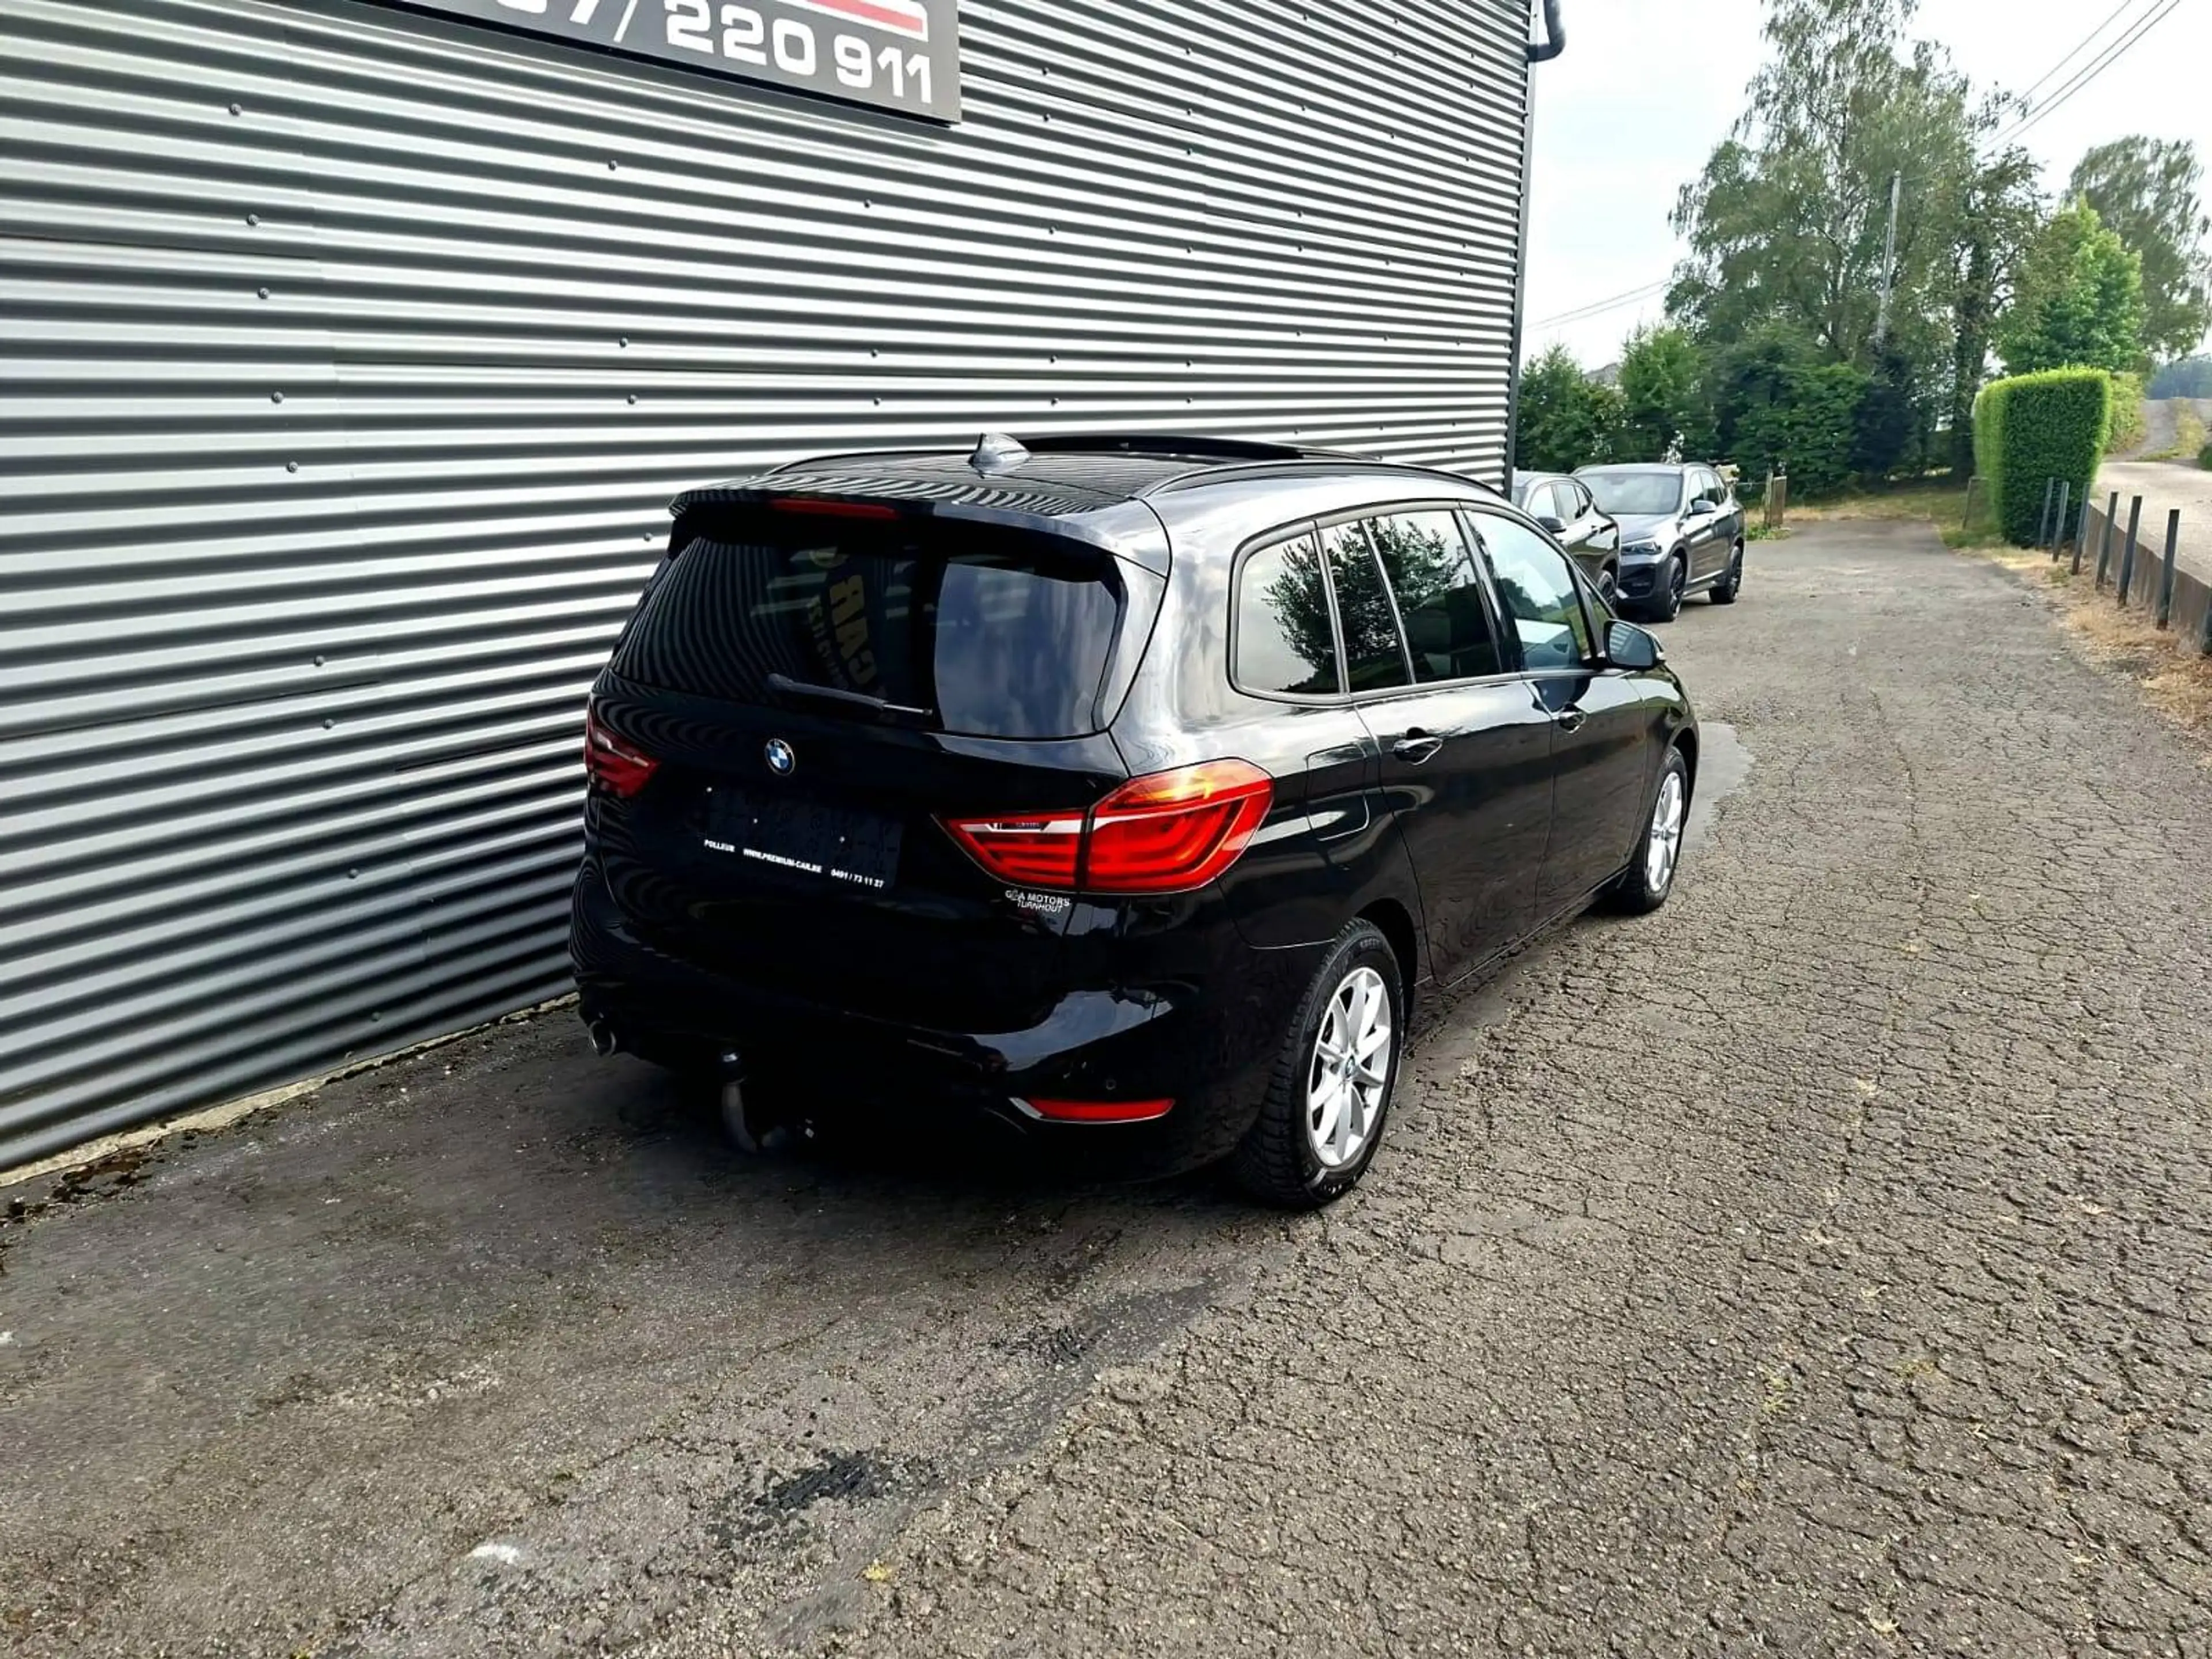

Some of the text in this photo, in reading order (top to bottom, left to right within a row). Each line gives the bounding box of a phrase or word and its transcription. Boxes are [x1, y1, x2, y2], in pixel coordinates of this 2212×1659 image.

[665, 0, 816, 75] 220
[834, 34, 932, 104] 911
[1017, 900, 1062, 913] TURNHOUT
[1027, 893, 1070, 907] MOTORS
